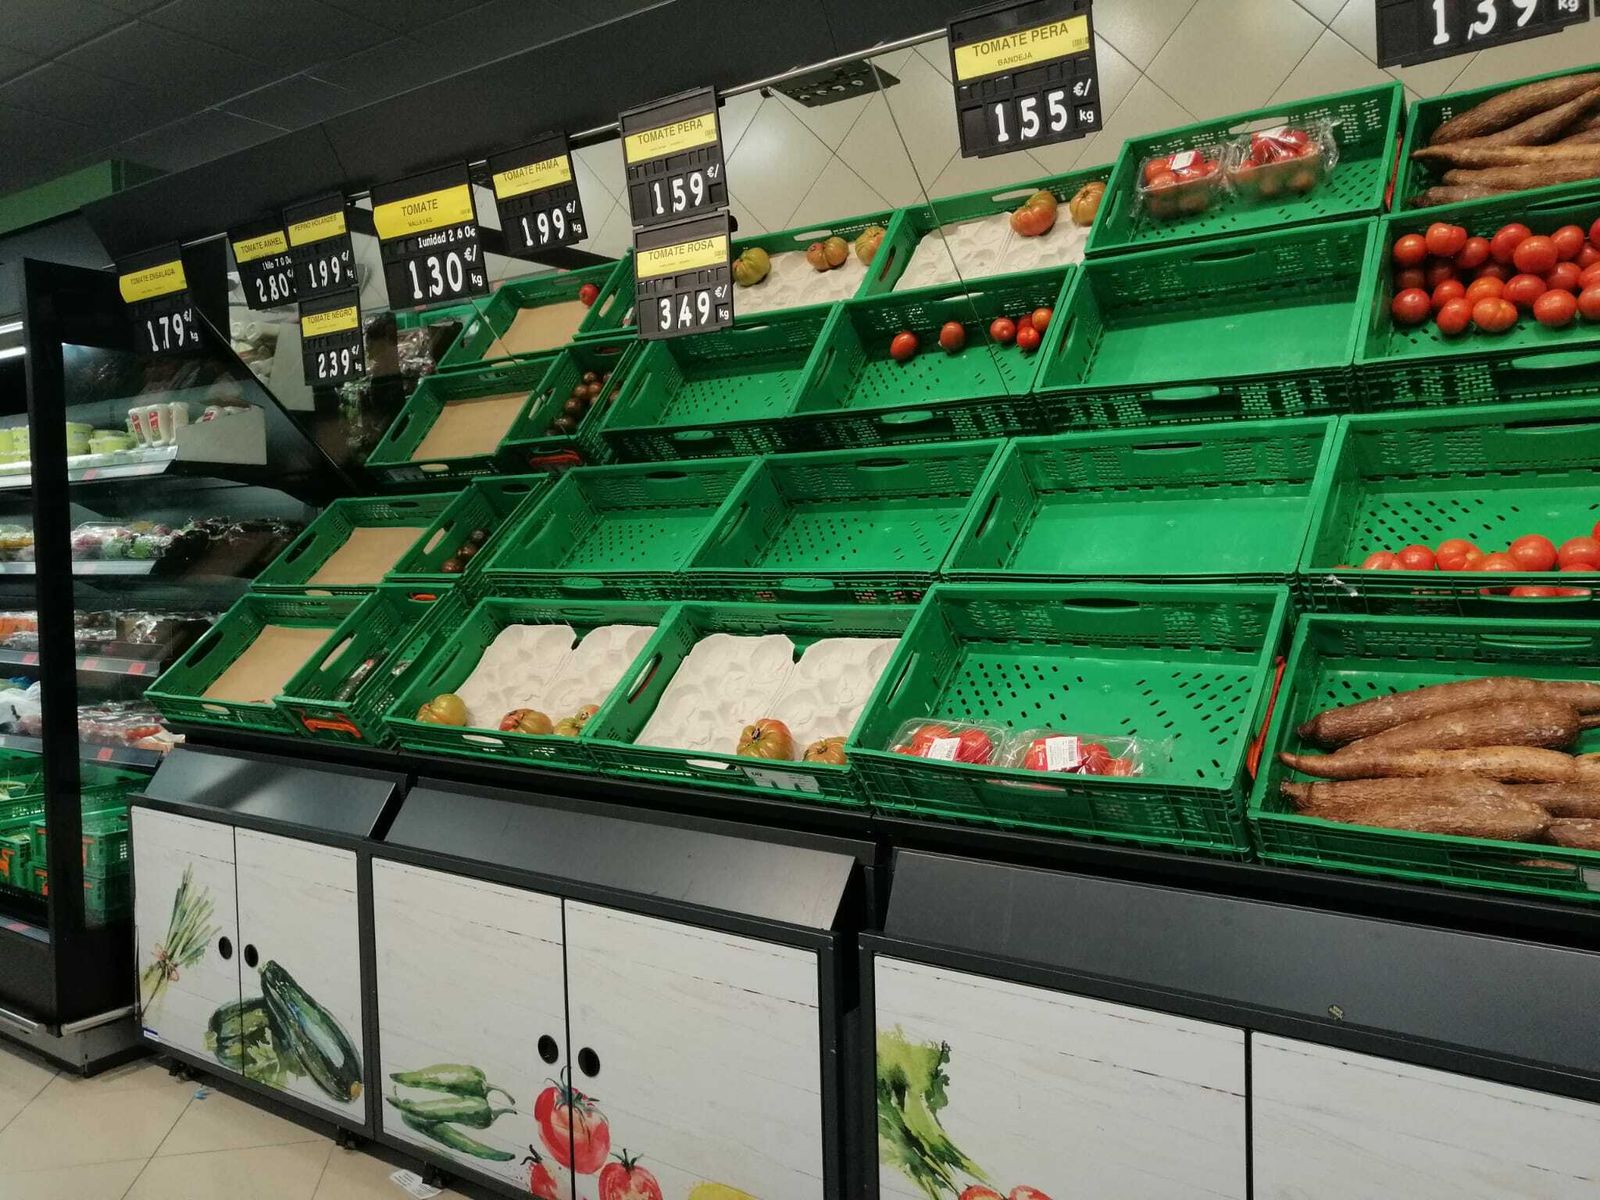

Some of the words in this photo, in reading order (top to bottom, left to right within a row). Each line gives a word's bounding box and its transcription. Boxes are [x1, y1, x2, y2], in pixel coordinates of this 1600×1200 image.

[972, 32, 1028, 57] TOMATE
[1030, 22, 1069, 42] PERA
[997, 52, 1033, 66] BANDEJA
[1079, 109, 1095, 123] kg
[638, 126, 676, 145] TOMATE
[677, 119, 704, 134] PERA
[503, 166, 534, 182] TOMATE
[535, 159, 559, 173] RAMA
[401, 199, 439, 217] TOMATE
[572, 222, 582, 233] kg
[240, 241, 264, 253] TOMATE
[648, 245, 686, 261] TOMATE
[687, 239, 714, 253] ROSA
[130, 274, 149, 285] TOMATE
[149, 267, 176, 281] ENSALADA
[471, 273, 483, 286] kg
[307, 313, 331, 324] TOMATE
[331, 308, 353, 319] NEGRO
[719, 308, 730, 321] kg
[190, 331, 199, 343] kg
